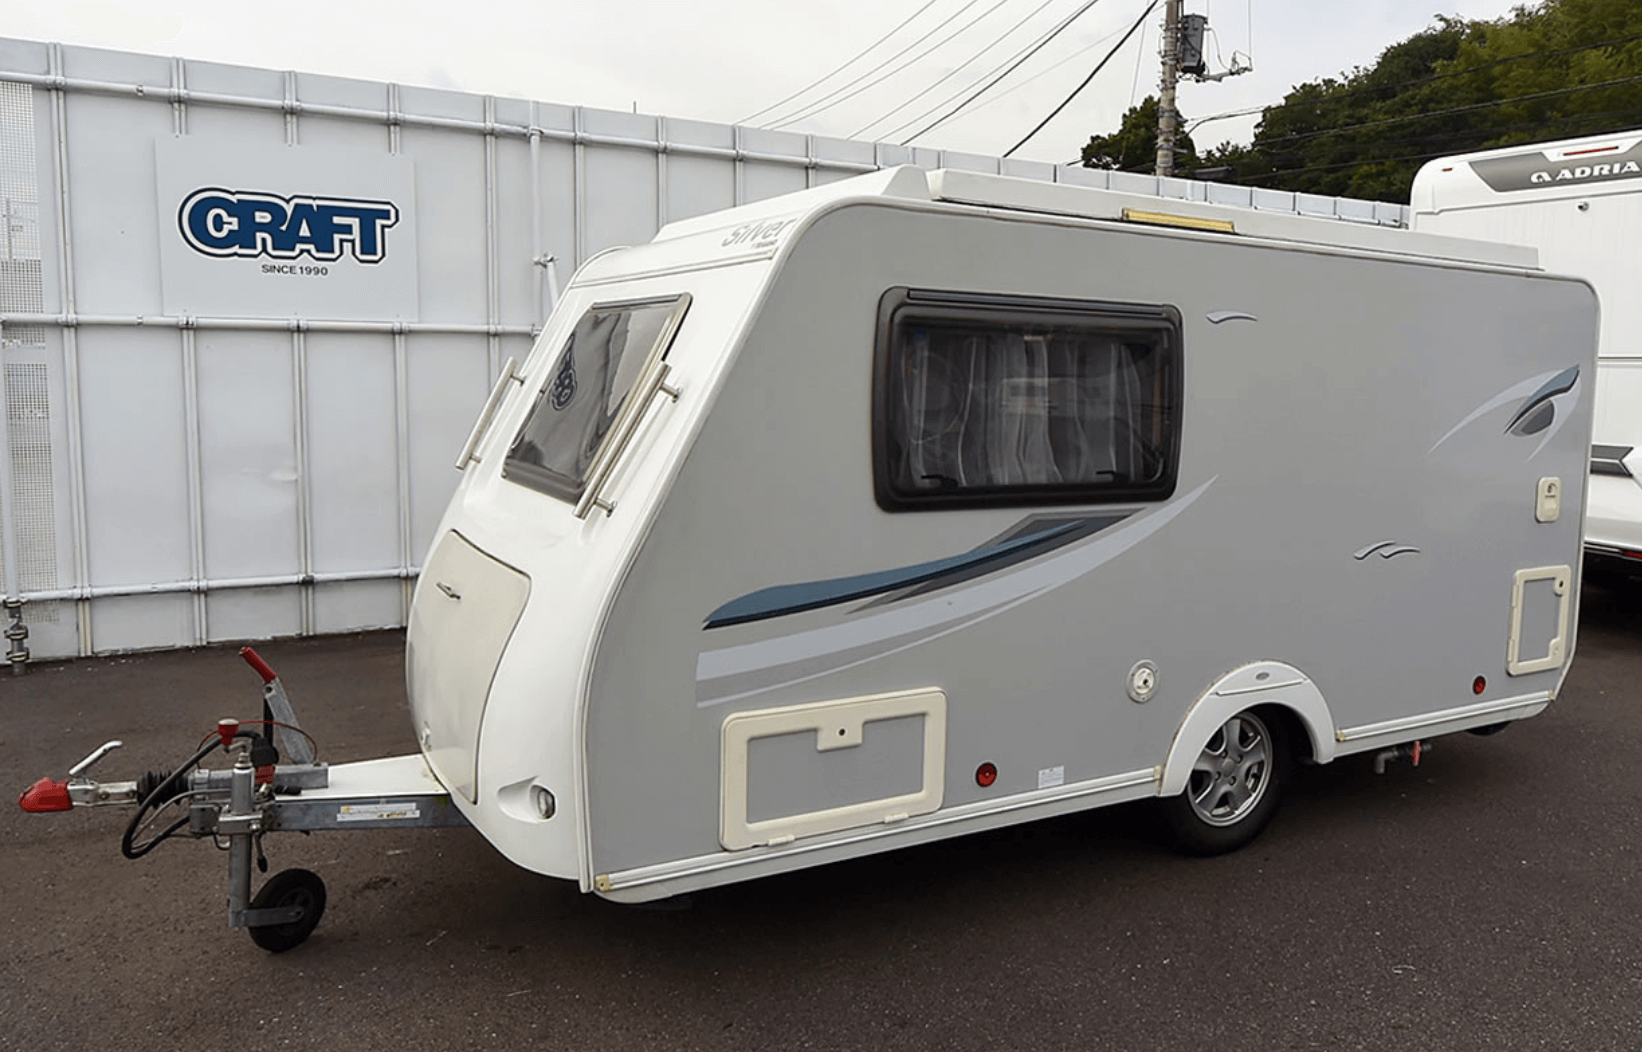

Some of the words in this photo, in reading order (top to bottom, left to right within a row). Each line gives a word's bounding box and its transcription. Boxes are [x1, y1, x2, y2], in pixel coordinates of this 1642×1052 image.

[1556, 160, 1641, 181] ADRIA
[178, 187, 400, 264] CRAFT
[261, 264, 296, 275] SINCE
[298, 265, 329, 277] 1990
